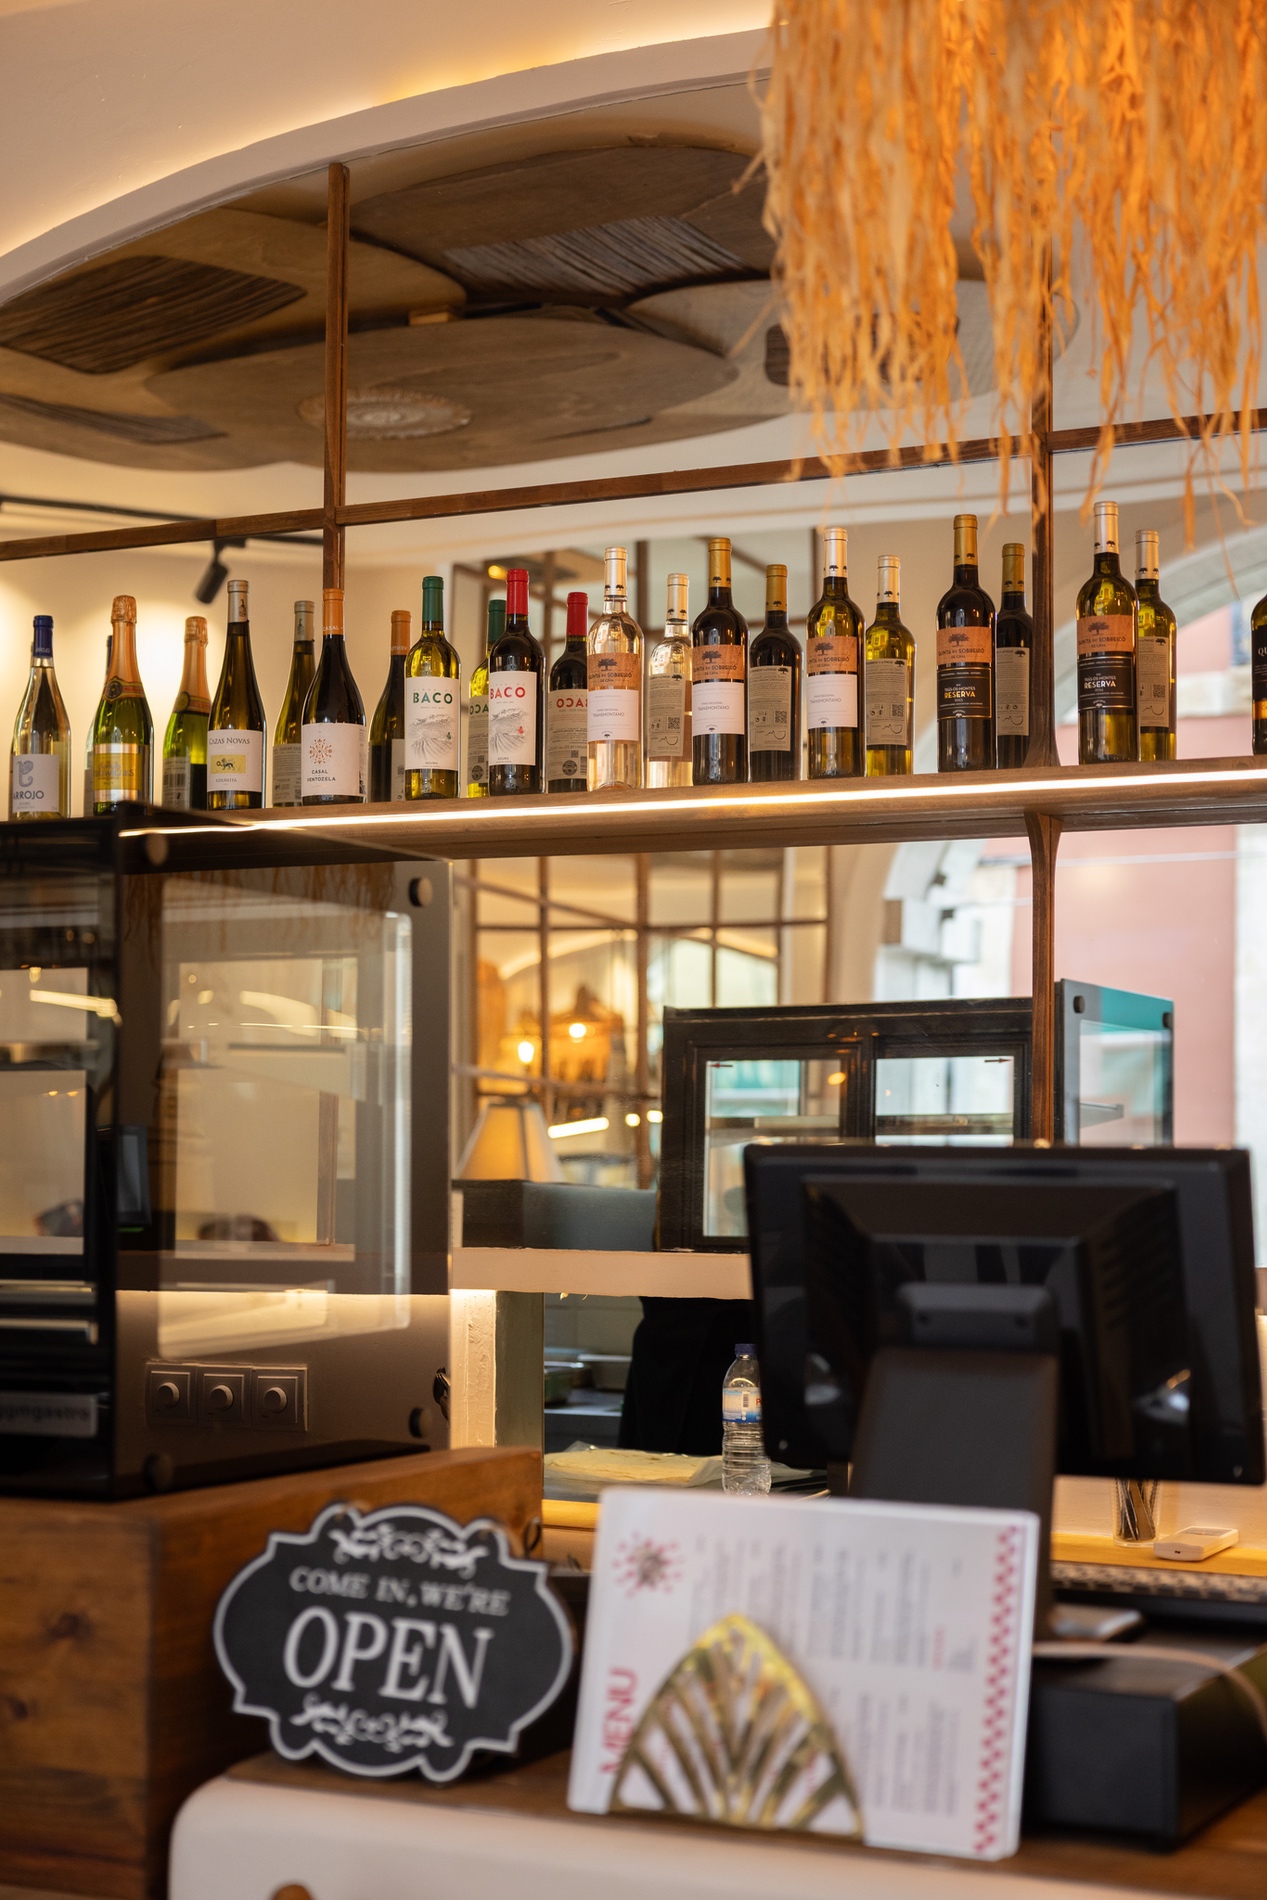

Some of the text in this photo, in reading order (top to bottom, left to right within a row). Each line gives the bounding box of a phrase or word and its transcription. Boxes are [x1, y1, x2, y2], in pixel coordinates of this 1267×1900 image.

[1084, 680, 1116, 688] RESERVA
[413, 692, 452, 704] BACO
[490, 686, 526, 700] BACO
[944, 690, 976, 698] RESERVA
[14, 790, 44, 800] ARROJO
[289, 1565, 370, 1599] COME
[420, 1579, 512, 1617] WE'RE
[283, 1604, 496, 1709] OPEN
